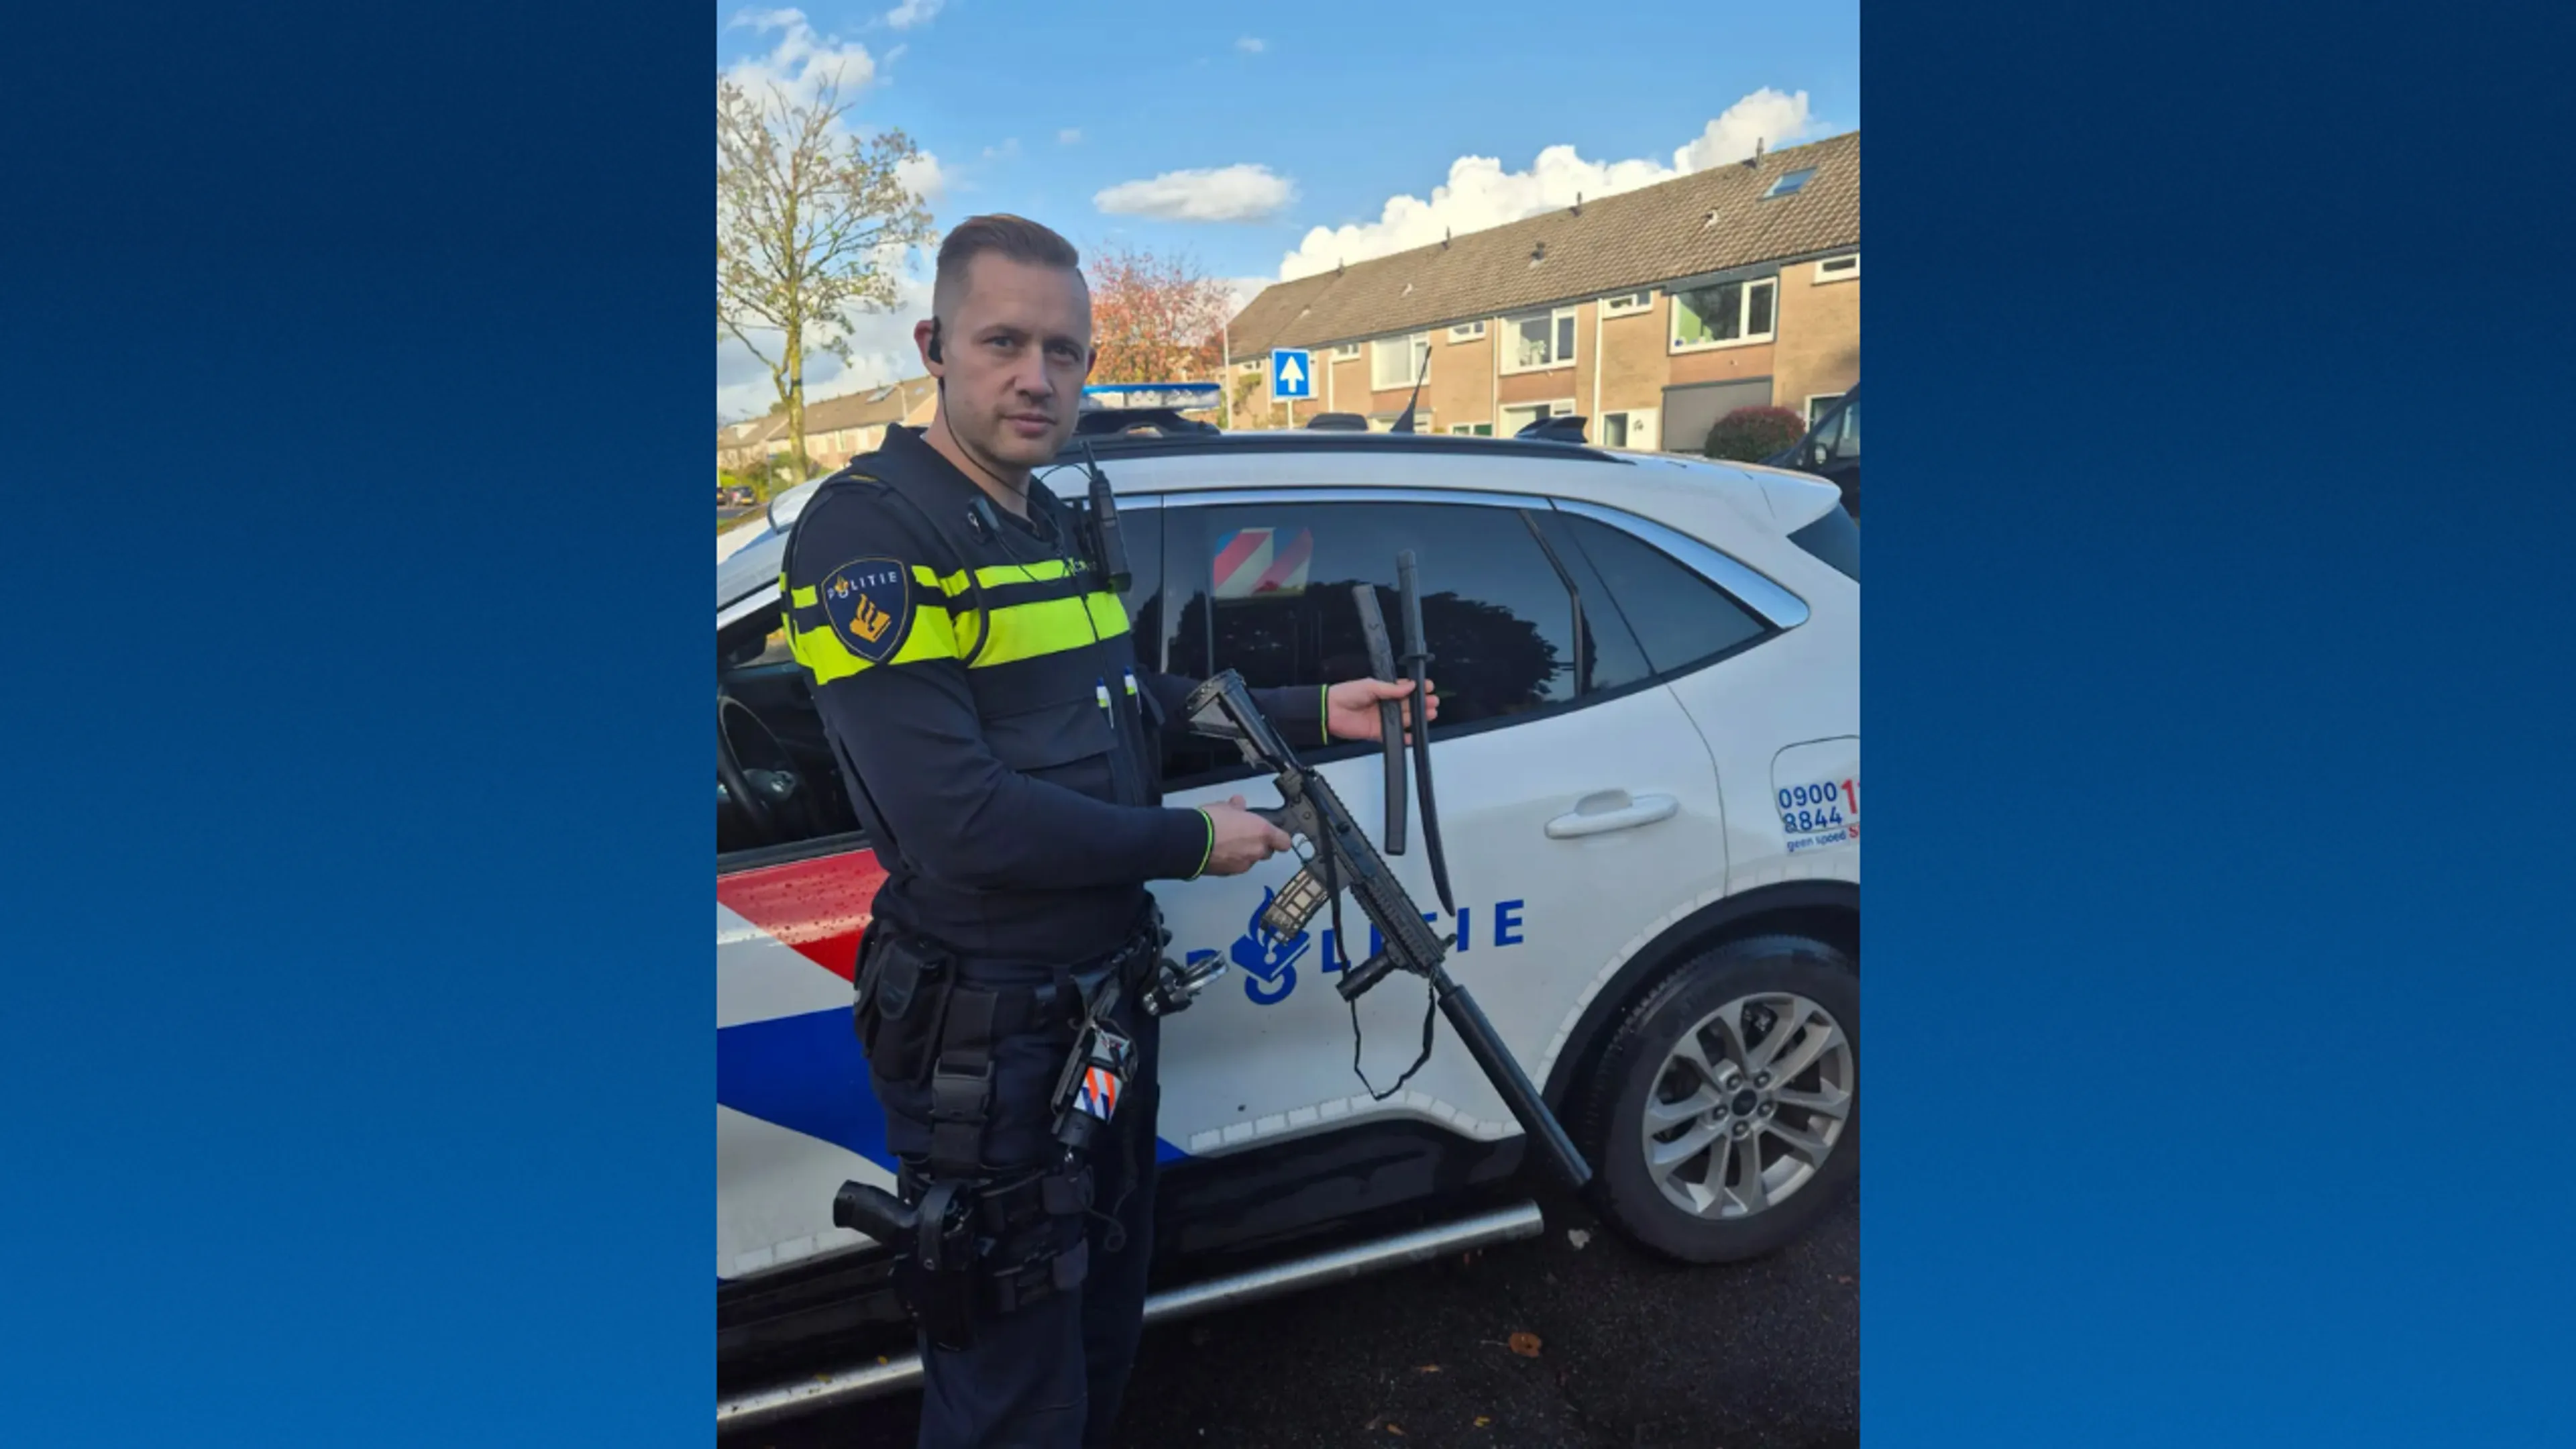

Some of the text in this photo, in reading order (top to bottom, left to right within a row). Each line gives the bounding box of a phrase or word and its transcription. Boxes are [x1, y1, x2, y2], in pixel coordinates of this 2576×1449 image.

[827, 571, 898, 600] POLITIE
[1779, 782, 1837, 809] 0900
[1841, 778, 1860, 814] 1
[1784, 806, 1843, 833] 8844
[1849, 824, 1860, 839] S
[1787, 830, 1847, 852] geen spoed
[1185, 900, 1524, 1005] OLIIE
